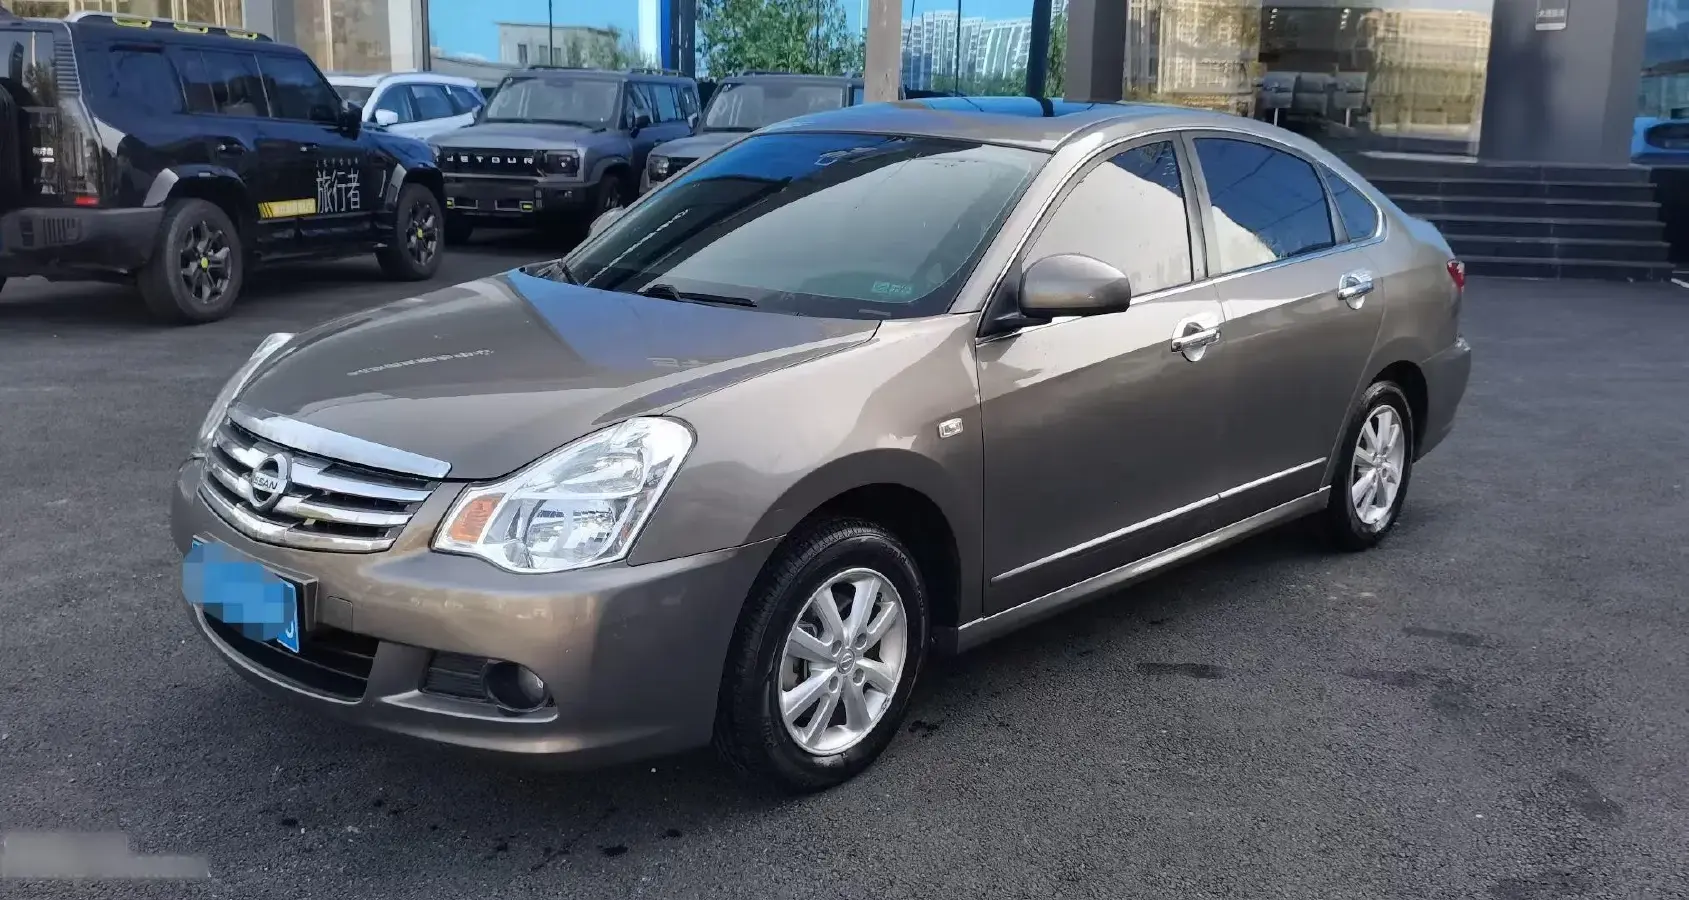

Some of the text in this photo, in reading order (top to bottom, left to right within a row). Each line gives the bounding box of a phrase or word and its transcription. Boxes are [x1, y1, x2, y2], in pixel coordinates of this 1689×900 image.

[446, 155, 533, 165] JETOUR
[316, 168, 360, 213] 旅行者
